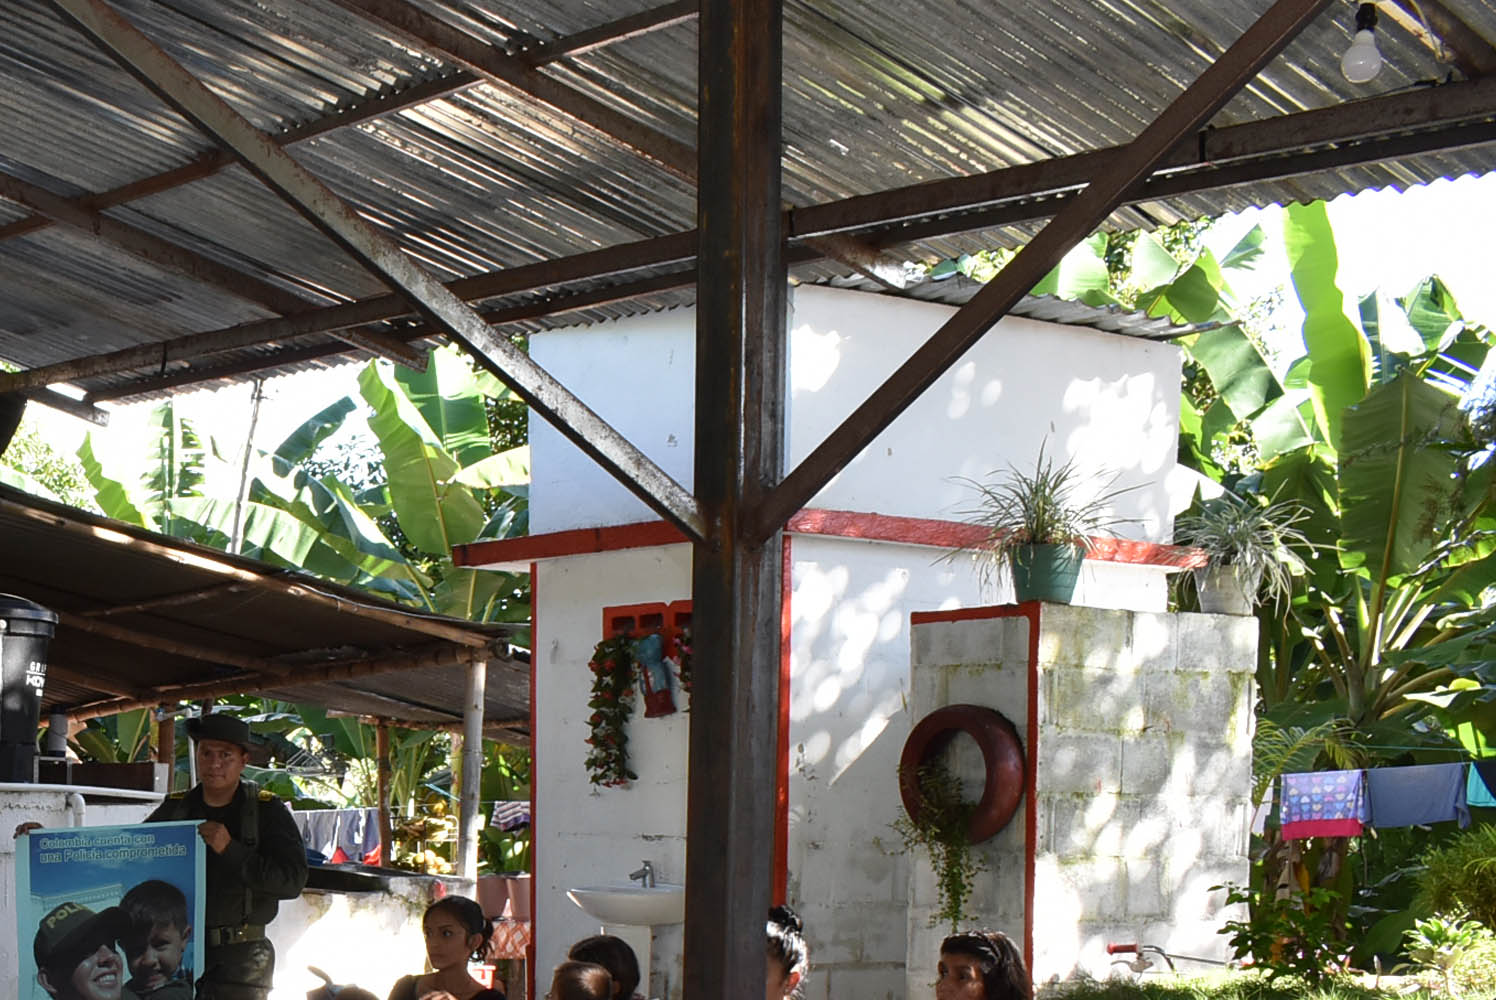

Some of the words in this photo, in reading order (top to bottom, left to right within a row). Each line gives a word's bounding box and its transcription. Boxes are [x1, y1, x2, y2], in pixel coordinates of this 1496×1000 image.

[40, 836, 92, 850] Colombia
[93, 834, 132, 847] cuenta
[135, 833, 156, 845] con
[39, 852, 63, 864] una
[104, 843, 187, 861] comprometida
